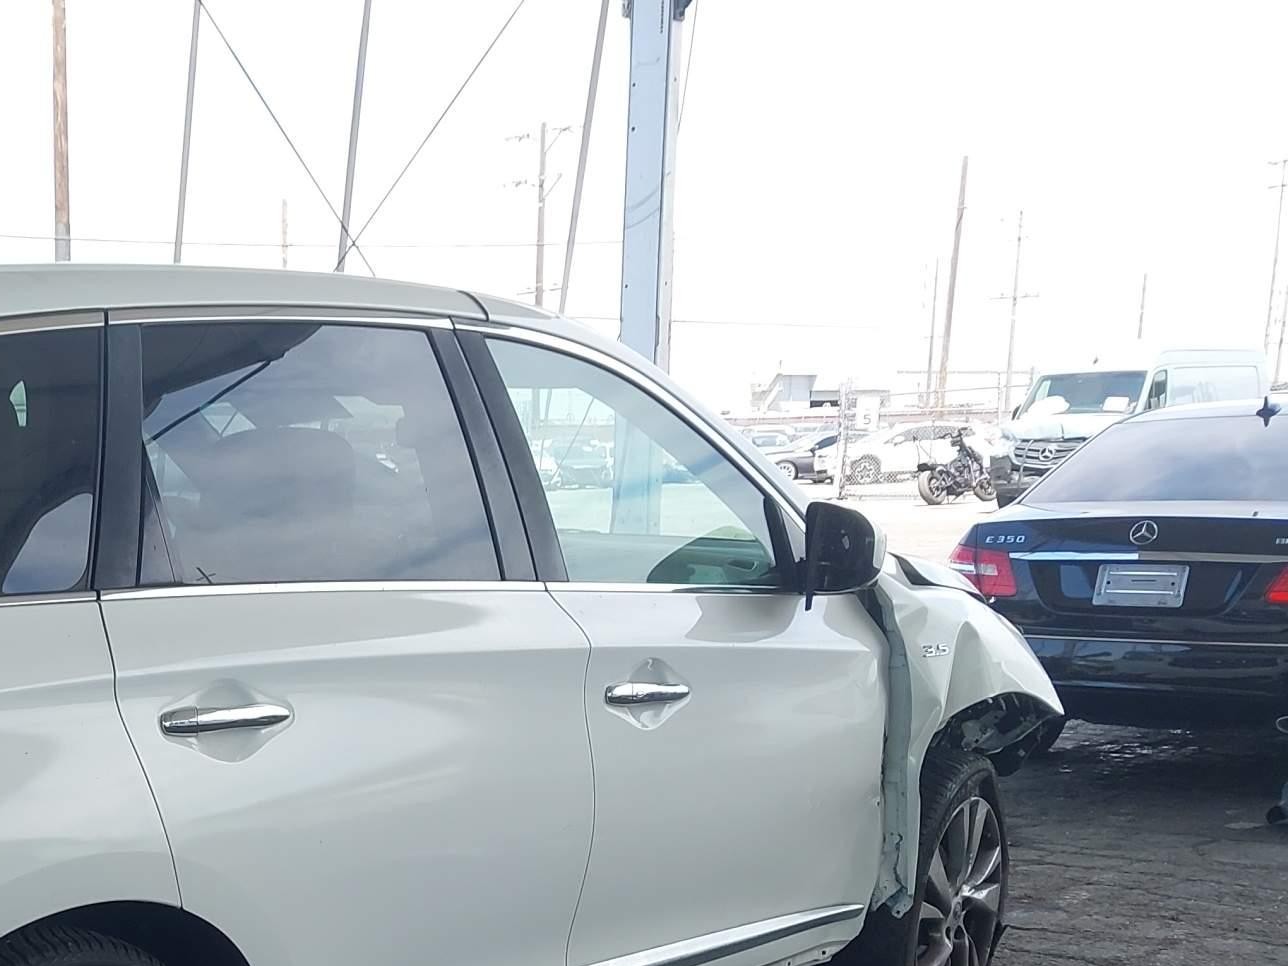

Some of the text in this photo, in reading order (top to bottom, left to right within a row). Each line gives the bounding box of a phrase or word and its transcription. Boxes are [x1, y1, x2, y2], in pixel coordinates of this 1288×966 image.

[863, 414, 872, 425] 5
[985, 535, 1026, 544] E 350
[922, 642, 950, 658] 3.5
